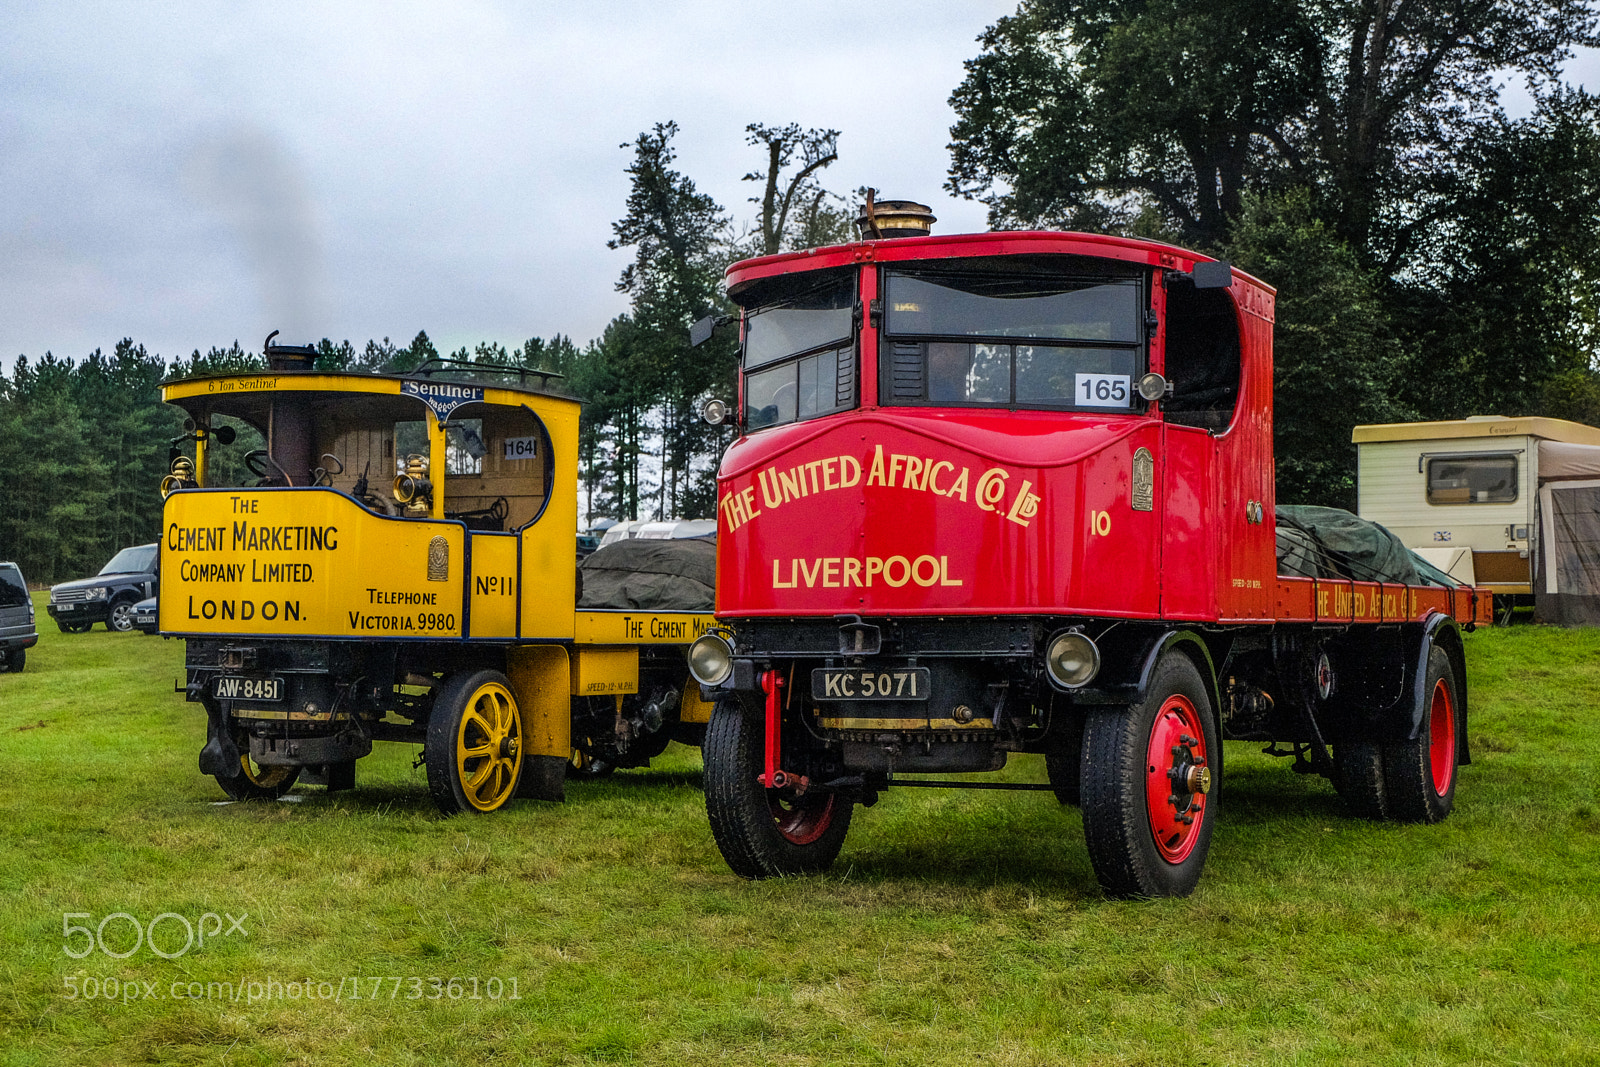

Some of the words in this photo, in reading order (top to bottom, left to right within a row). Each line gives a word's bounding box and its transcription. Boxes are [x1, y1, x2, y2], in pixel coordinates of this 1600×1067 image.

[208, 381, 215, 392] 6
[219, 380, 234, 391] Ton
[1081, 379, 1126, 401] 165
[509, 440, 533, 455] 164
[720, 485, 761, 533] THE
[757, 455, 861, 509] UNITED
[866, 444, 970, 503] AFRICA
[230, 496, 259, 514] THE
[1091, 510, 1111, 537] 10
[168, 522, 226, 552] CEMENT
[232, 520, 338, 551] MARKETING
[180, 559, 246, 583] COMPANY
[252, 558, 315, 584] LIMITED.
[772, 554, 963, 589] LIVERPOOL
[188, 595, 307, 621] LONDON.
[366, 588, 437, 606] TELEPHONE
[624, 616, 643, 638] THE
[651, 617, 687, 638] CEMENT
[825, 673, 854, 697] KC
[860, 673, 917, 697] 5071
